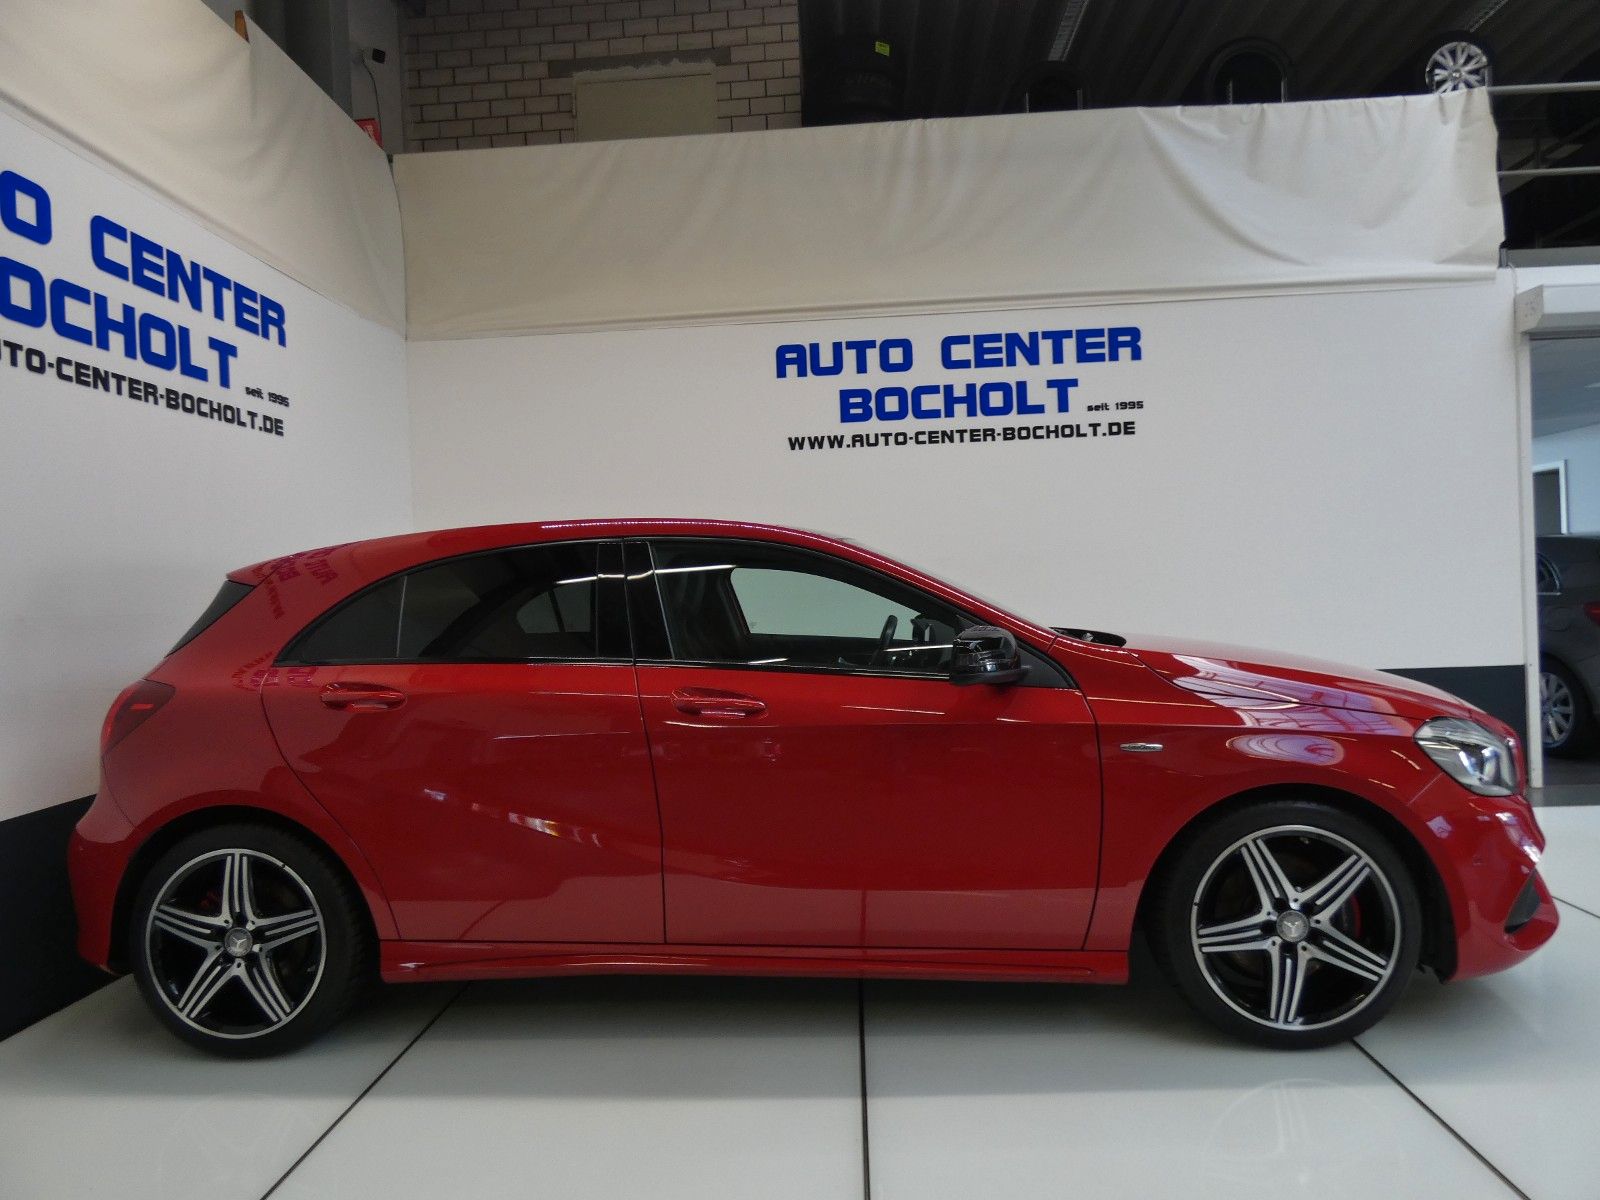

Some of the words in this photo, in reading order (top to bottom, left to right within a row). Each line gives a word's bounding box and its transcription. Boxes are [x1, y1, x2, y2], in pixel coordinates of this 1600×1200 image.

[90, 215, 287, 348] CENTER
[776, 338, 913, 379] AUTO
[941, 326, 1143, 370] CENTER
[0, 339, 285, 437] TO-CENTER-BOCHOLT.DE
[245, 386, 264, 400] seit
[268, 391, 290, 408] 1995
[839, 377, 1079, 424] BOCHOLT
[1087, 402, 1110, 412] seit
[1115, 400, 1144, 410] 1995
[787, 420, 1136, 451] WWW.AUTO-CENTER-BOCHOLT.DE
